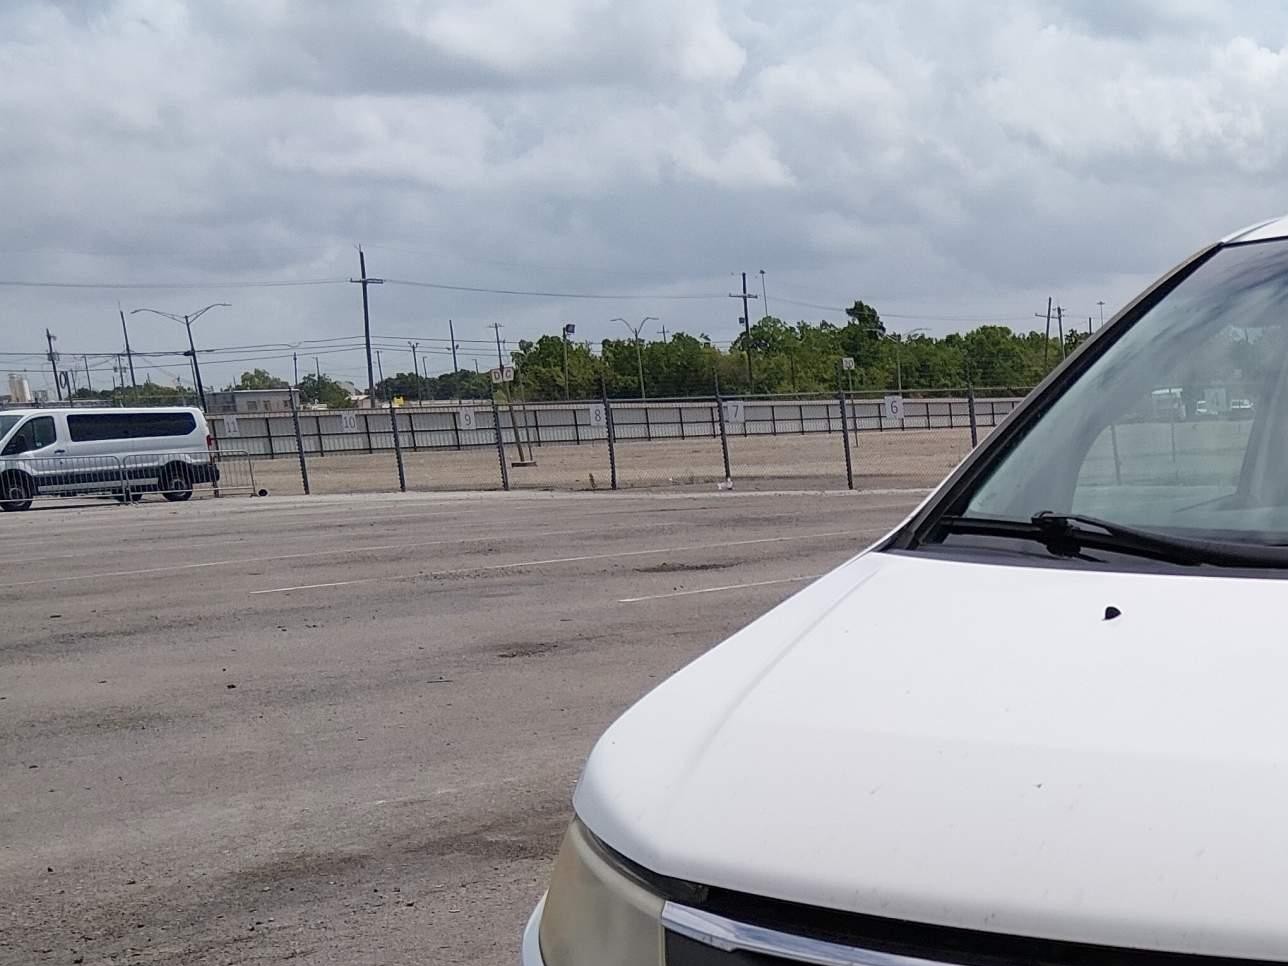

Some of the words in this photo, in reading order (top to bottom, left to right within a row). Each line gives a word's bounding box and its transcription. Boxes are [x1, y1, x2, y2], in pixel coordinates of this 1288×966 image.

[731, 404, 740, 418] 7
[890, 400, 899, 414] 6
[343, 415, 356, 429] 10
[464, 413, 472, 426] 9
[594, 408, 602, 422] 8
[226, 421, 239, 433] 11
